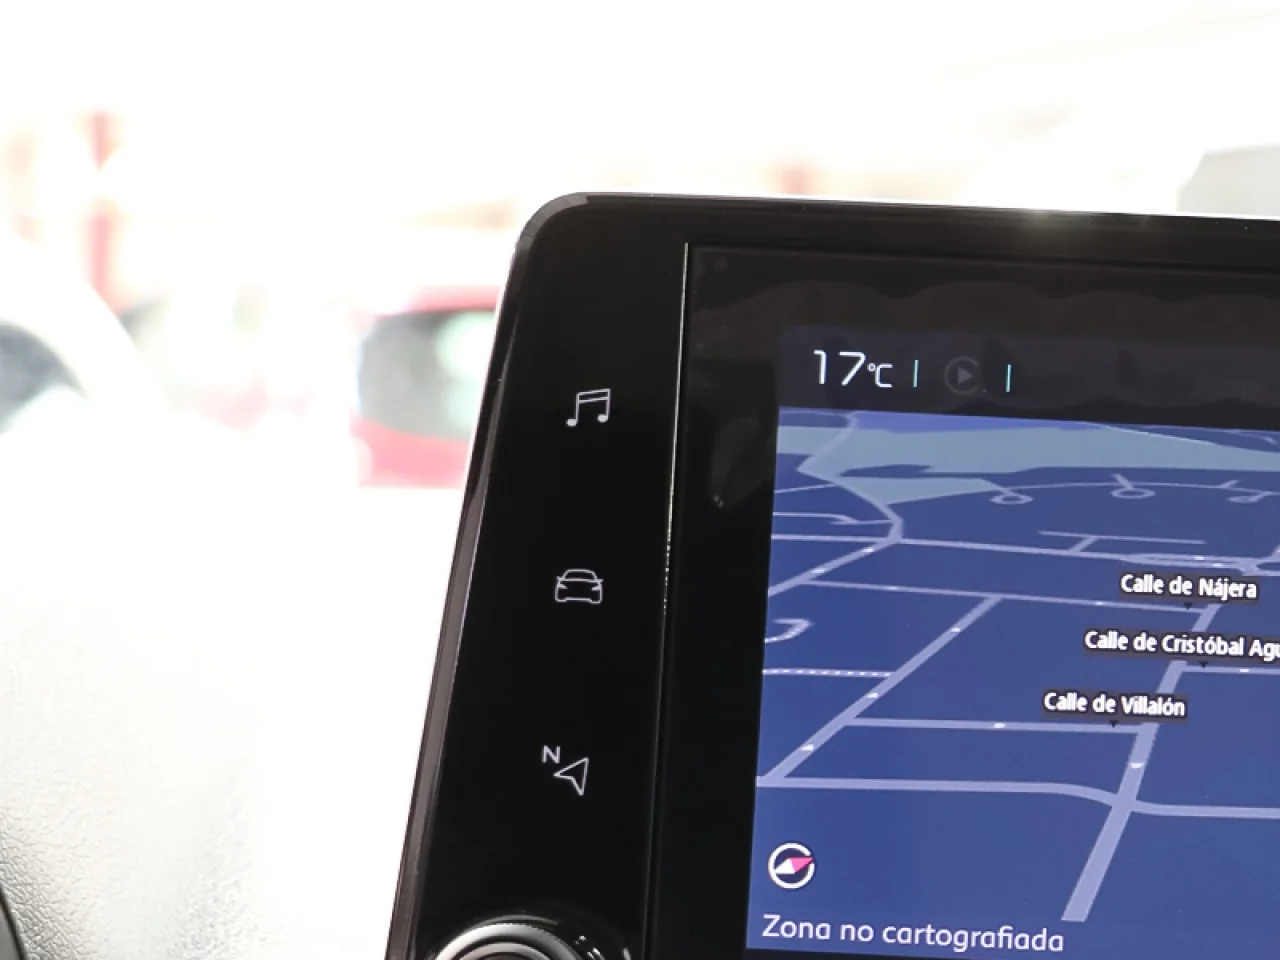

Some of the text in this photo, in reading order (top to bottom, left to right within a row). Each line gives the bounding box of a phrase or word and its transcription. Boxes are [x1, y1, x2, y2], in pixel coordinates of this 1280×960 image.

[1120, 573, 1257, 601] Calle de Nájera
[1084, 630, 1129, 651] Calle
[1132, 631, 1158, 652] de
[1161, 634, 1245, 656] Cristóbal
[1044, 692, 1185, 716] Calle de Villalón
[761, 913, 1065, 953] Zona no cartografiada
